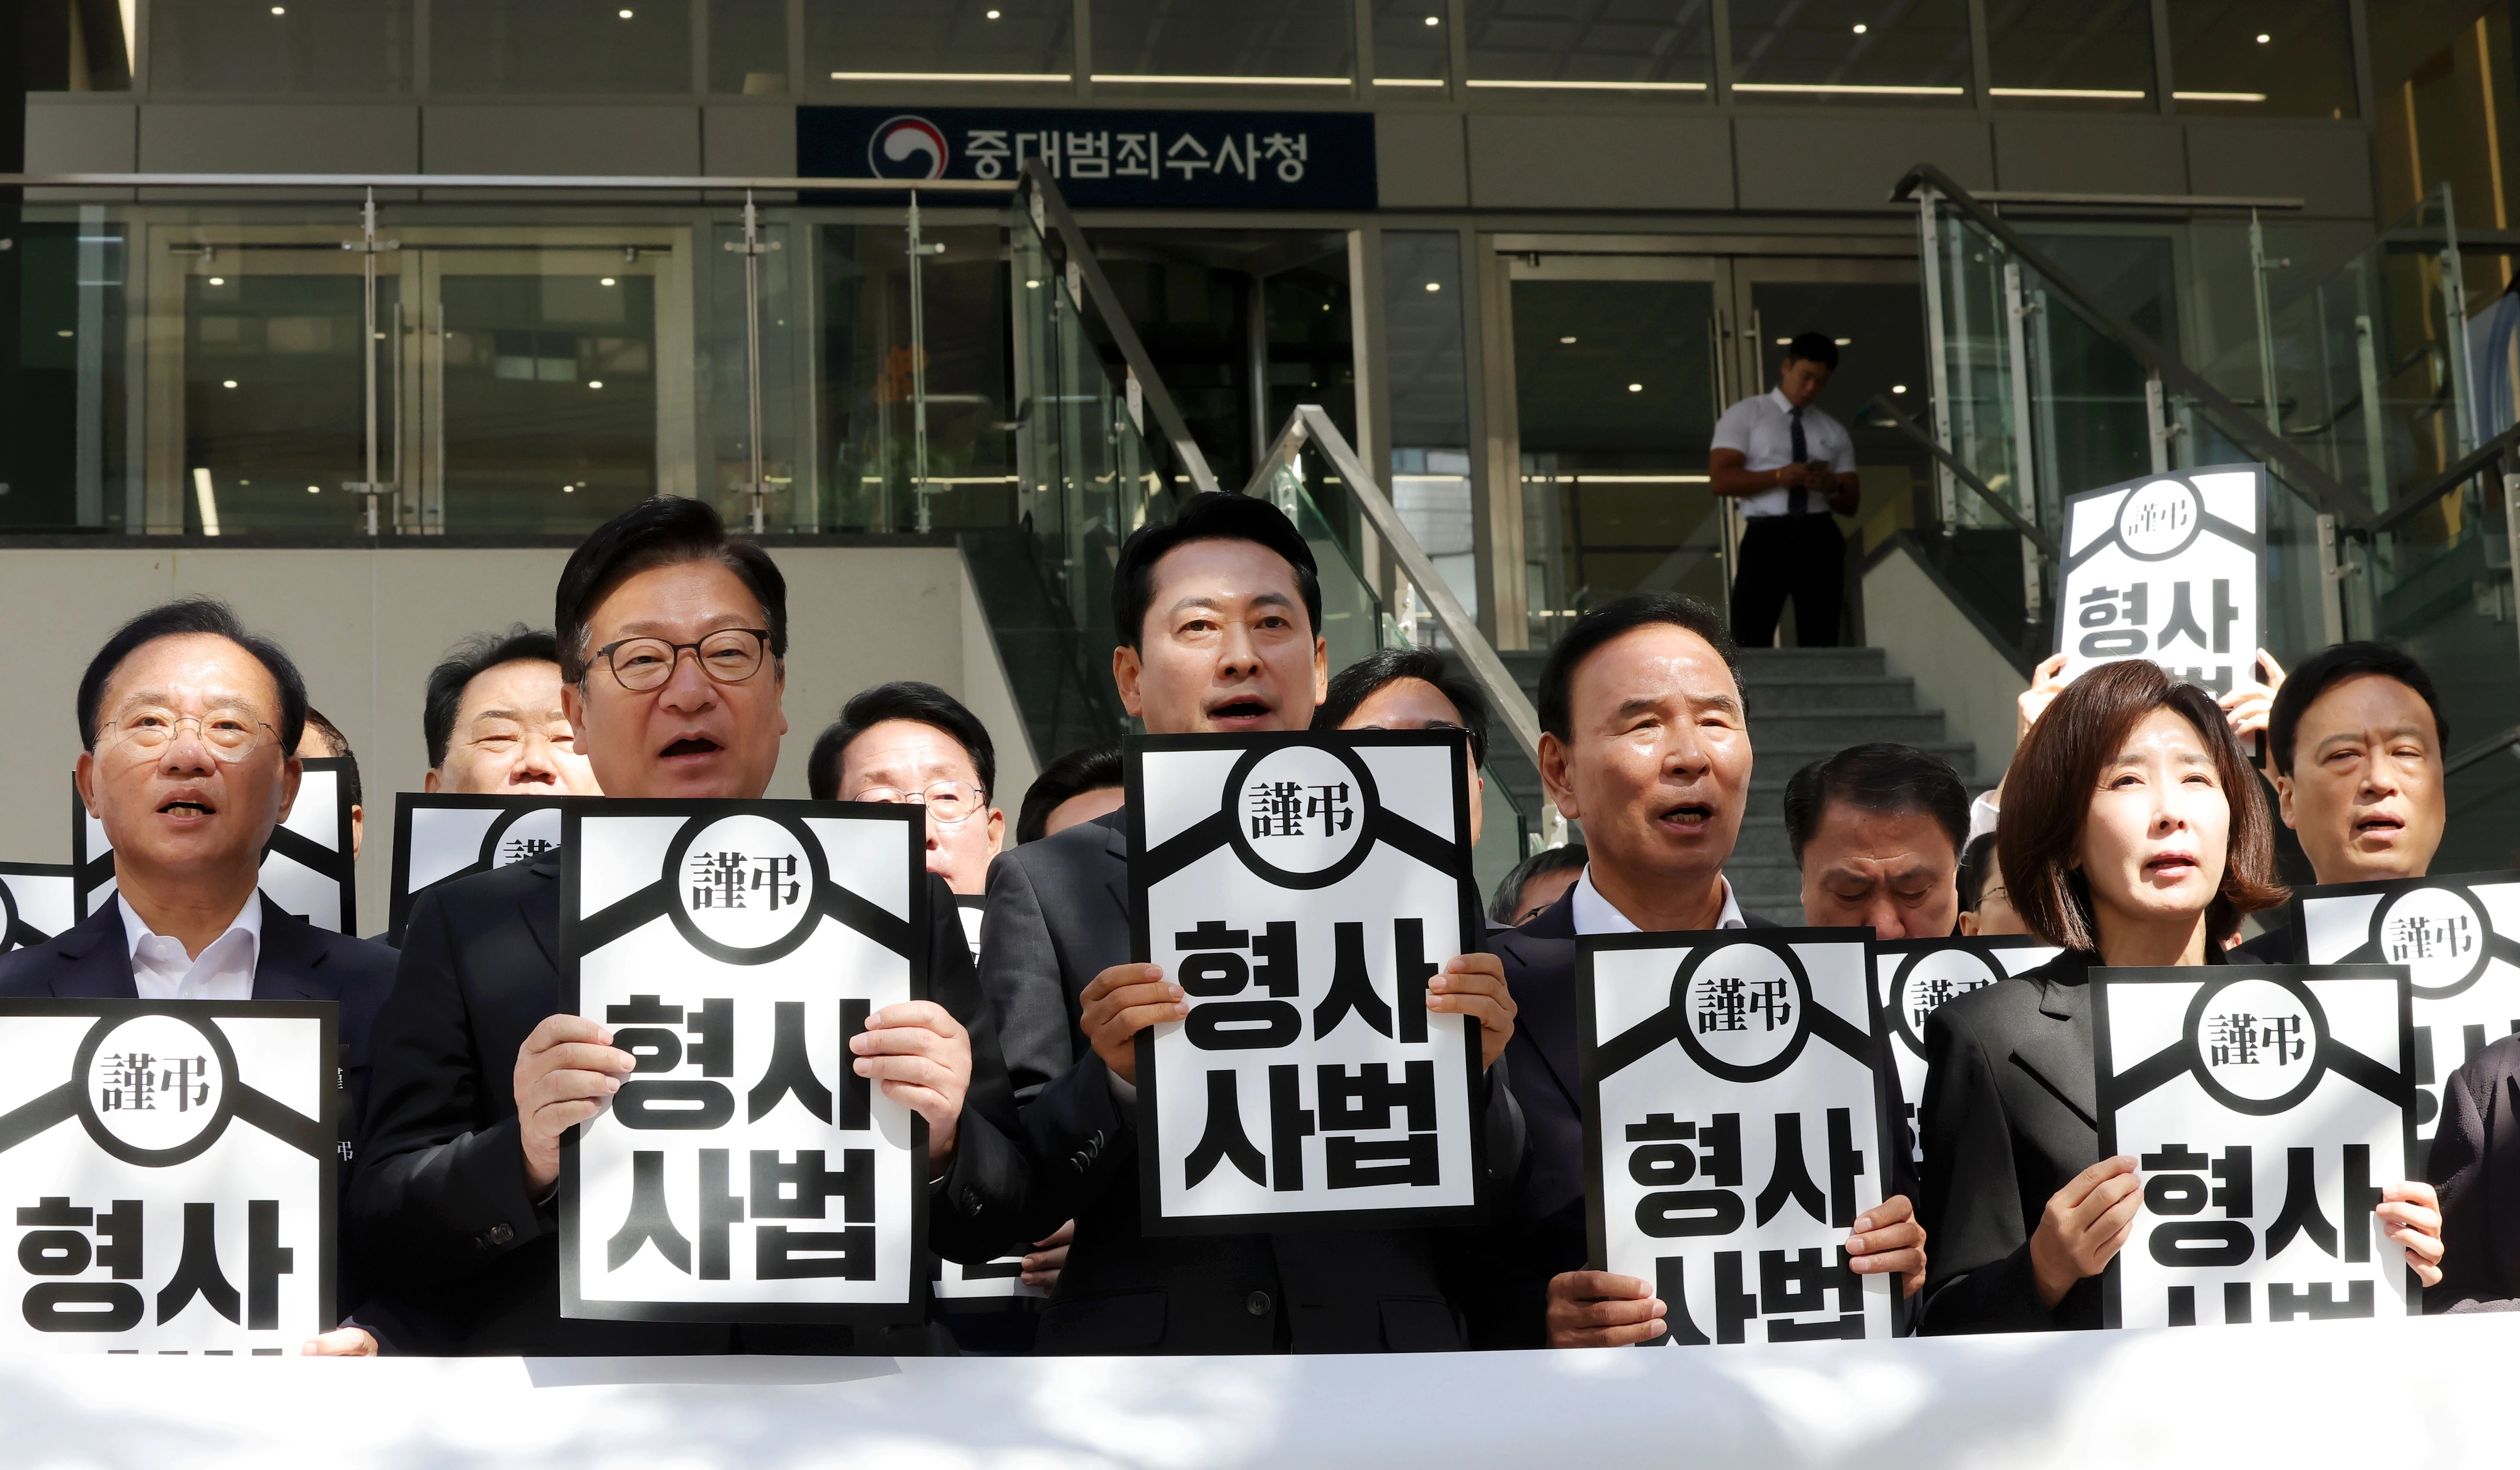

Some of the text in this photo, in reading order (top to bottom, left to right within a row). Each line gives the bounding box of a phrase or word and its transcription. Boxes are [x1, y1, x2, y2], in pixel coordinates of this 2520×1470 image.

[965, 130, 1307, 182] 중대범죄수사청
[2079, 579, 2239, 659] 형사
[1249, 781, 1354, 839] 謹弔
[690, 852, 801, 911] 謹弔
[2389, 914, 2473, 962] 謹弔
[1175, 918, 1438, 1051] 형사
[1695, 977, 1792, 1034] 謹弔
[100, 1053, 210, 1113] 謹弔
[607, 995, 872, 1131] 형사
[2207, 1013, 2306, 1067] 謹弔
[1185, 1061, 1440, 1192] 사법
[607, 1149, 876, 1281] 사법
[1625, 1108, 1864, 1238] 형사
[2141, 1144, 2384, 1267] 형사
[16, 1197, 293, 1333] 형사
[1635, 1245, 1865, 1347] 사법
